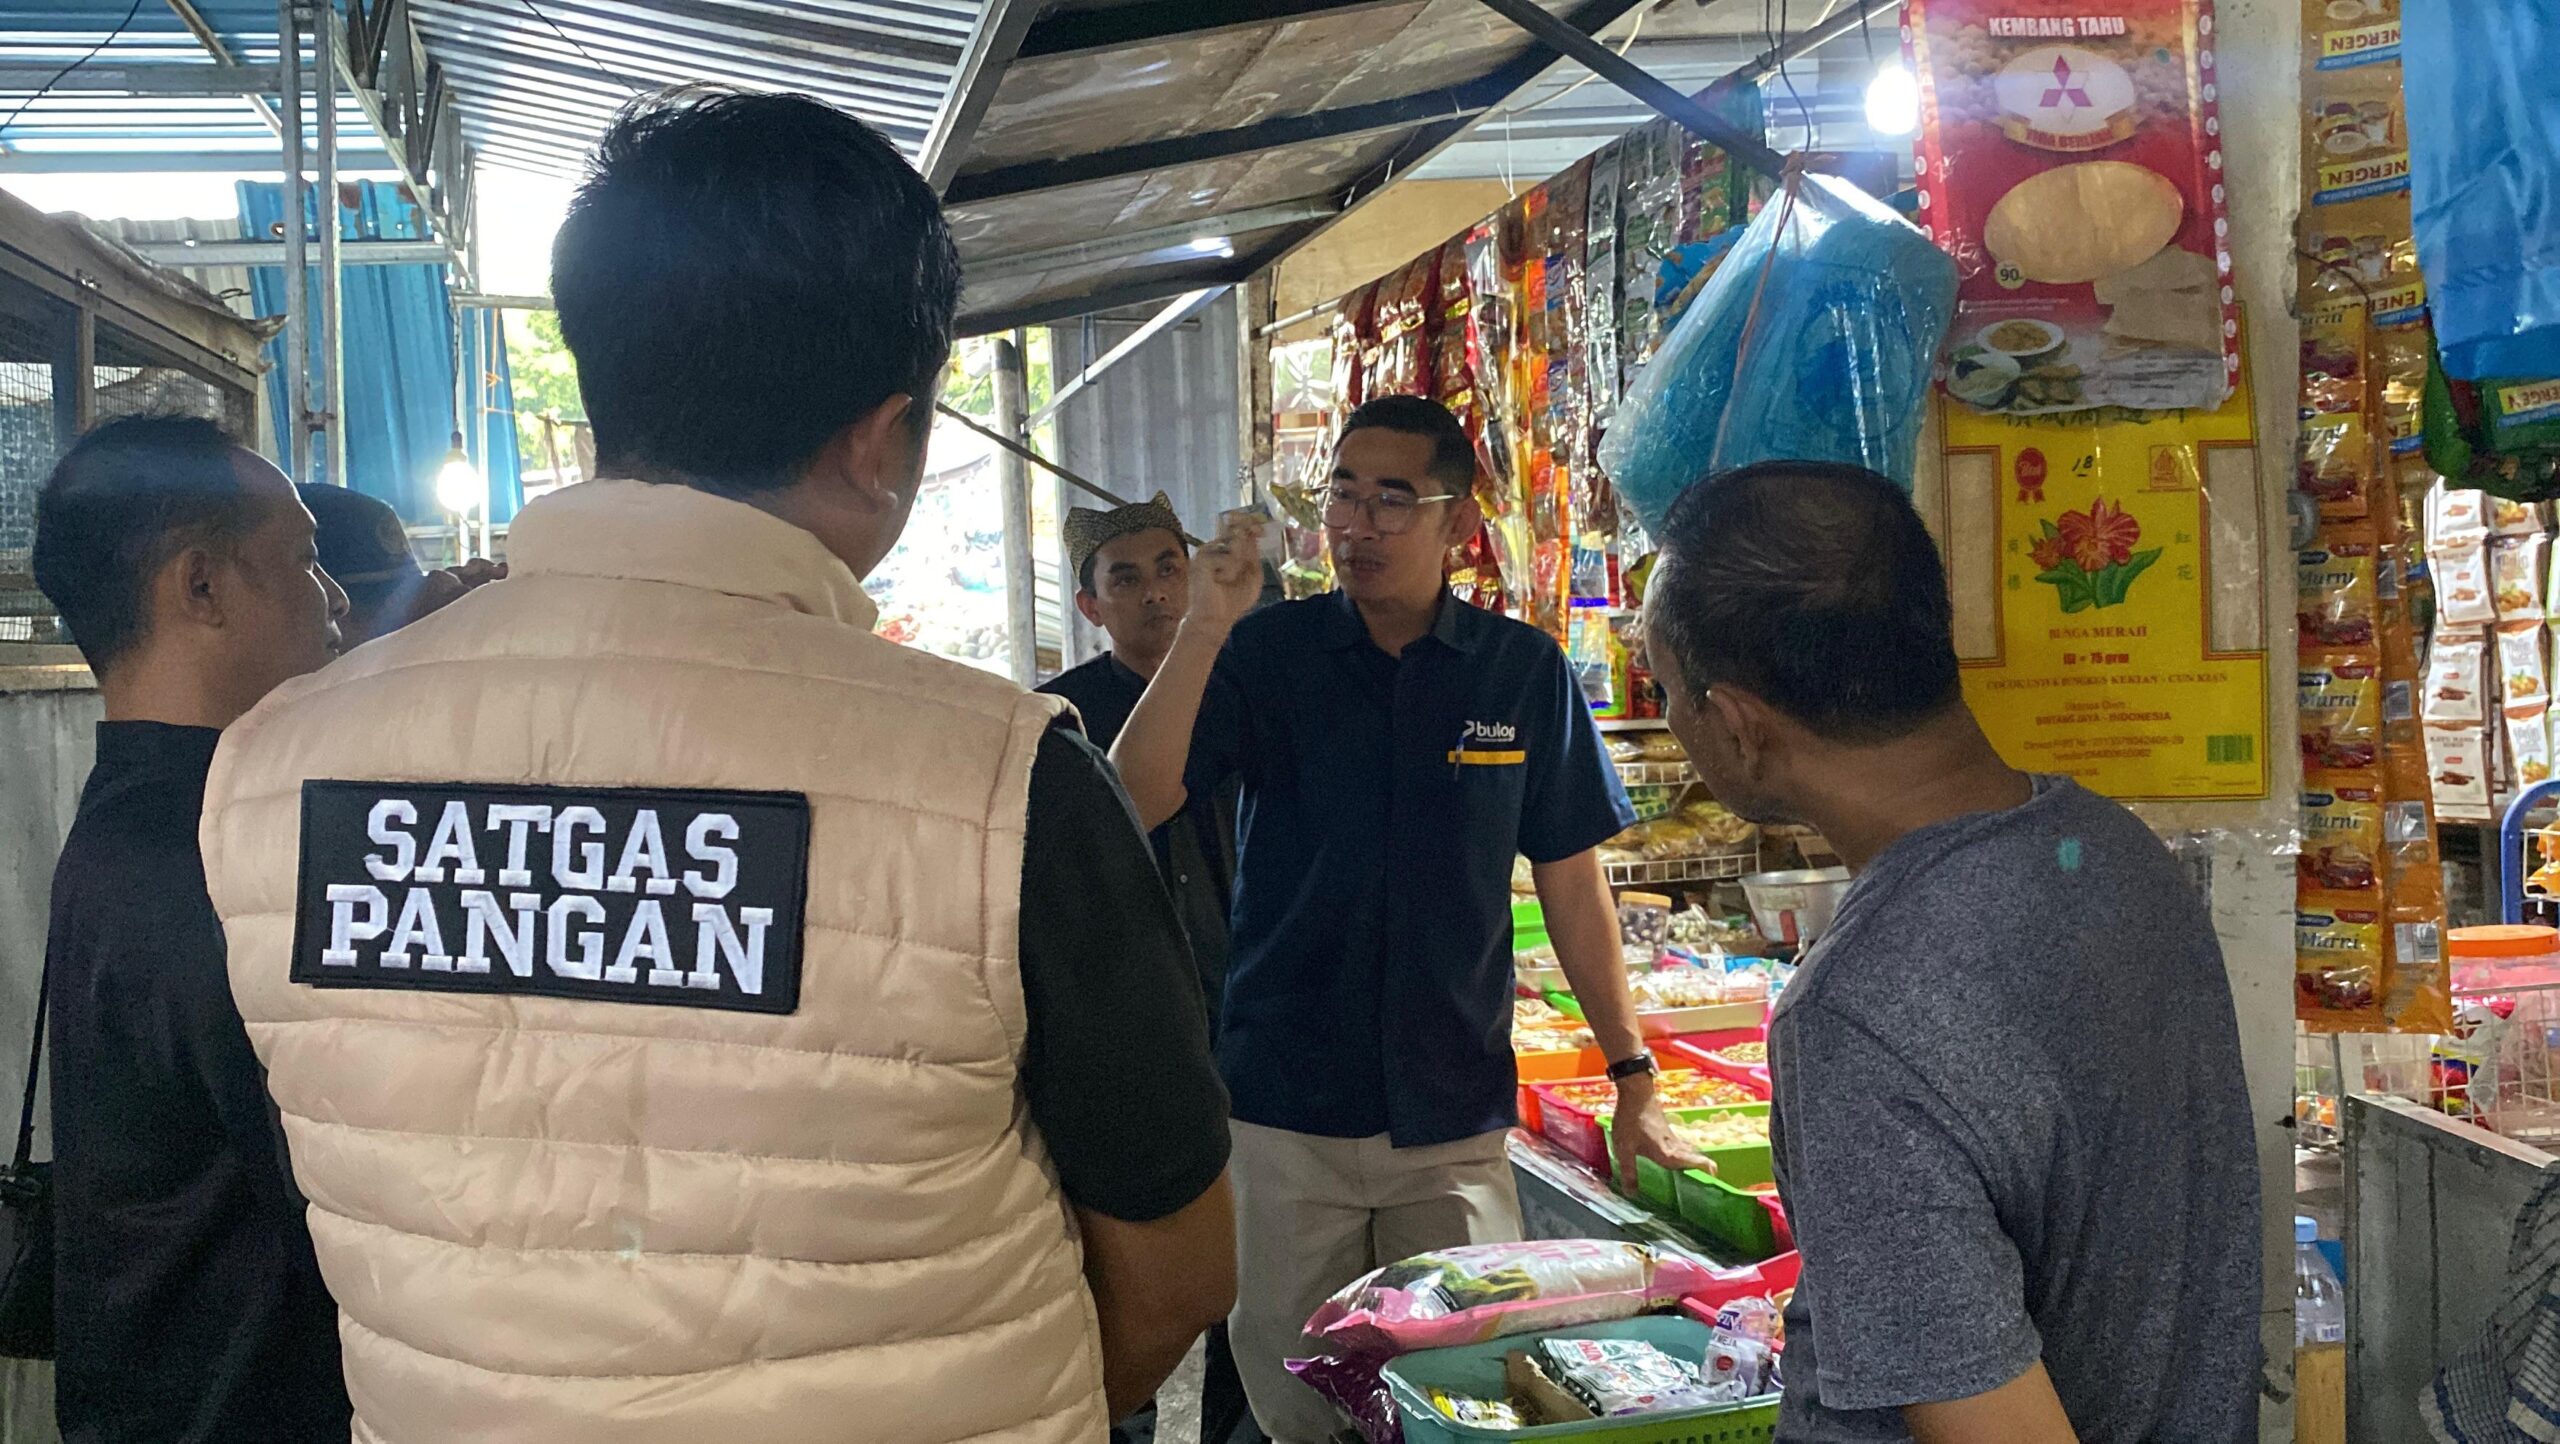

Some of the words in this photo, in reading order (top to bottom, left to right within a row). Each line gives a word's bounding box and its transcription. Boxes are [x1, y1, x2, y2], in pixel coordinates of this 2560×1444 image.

[1989, 17, 2075, 37] KEMBANG
[2077, 16, 2125, 36] TAHU
[2330, 28, 2401, 51] NERGEN
[2328, 160, 2407, 185] NERGEN
[2000, 268, 2020, 281] 90
[2092, 626, 2147, 638] MERAH
[1476, 721, 1516, 742] bulog
[363, 799, 740, 899] SATGAS
[321, 883, 774, 996] PANGAN
[2301, 931, 2360, 949] Murni
